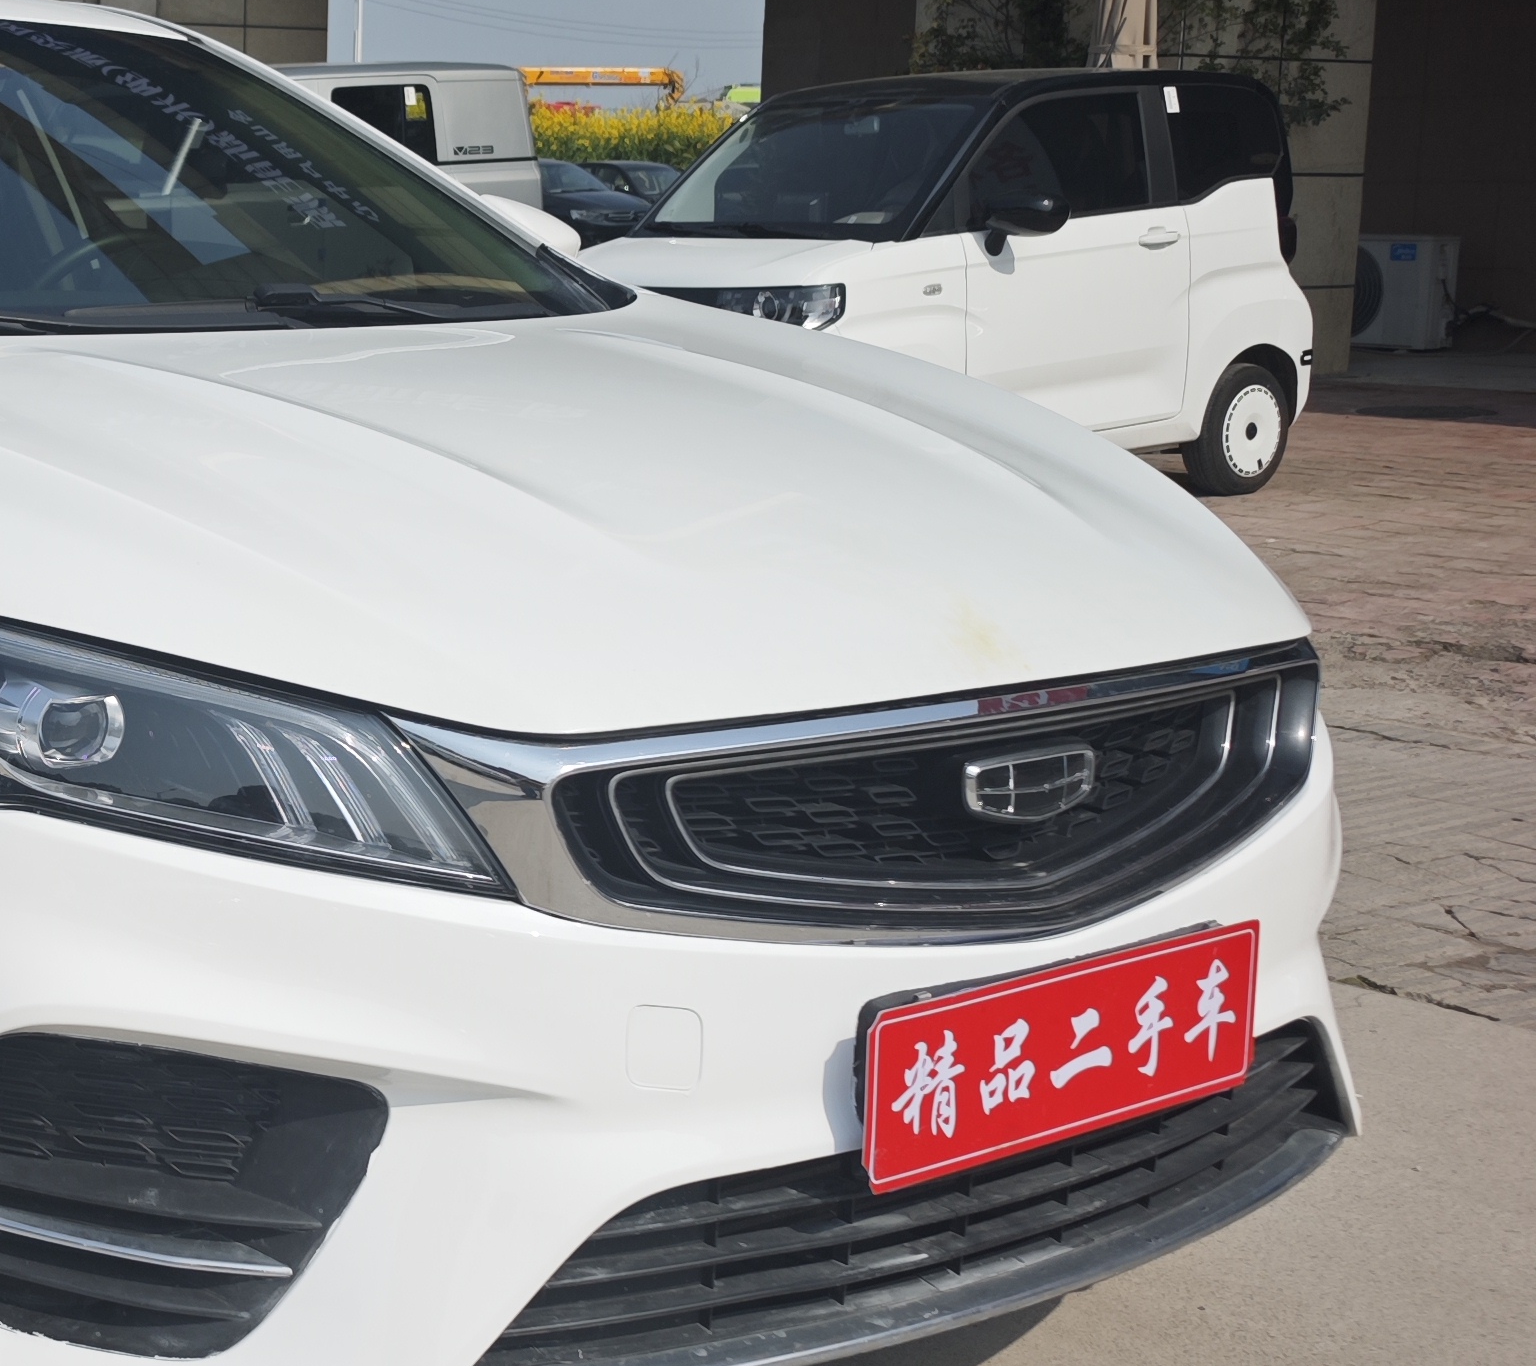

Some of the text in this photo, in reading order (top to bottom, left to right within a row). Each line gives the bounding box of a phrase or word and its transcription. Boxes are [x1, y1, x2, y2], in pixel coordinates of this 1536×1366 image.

[891, 957, 1237, 1139] 精品二手车
